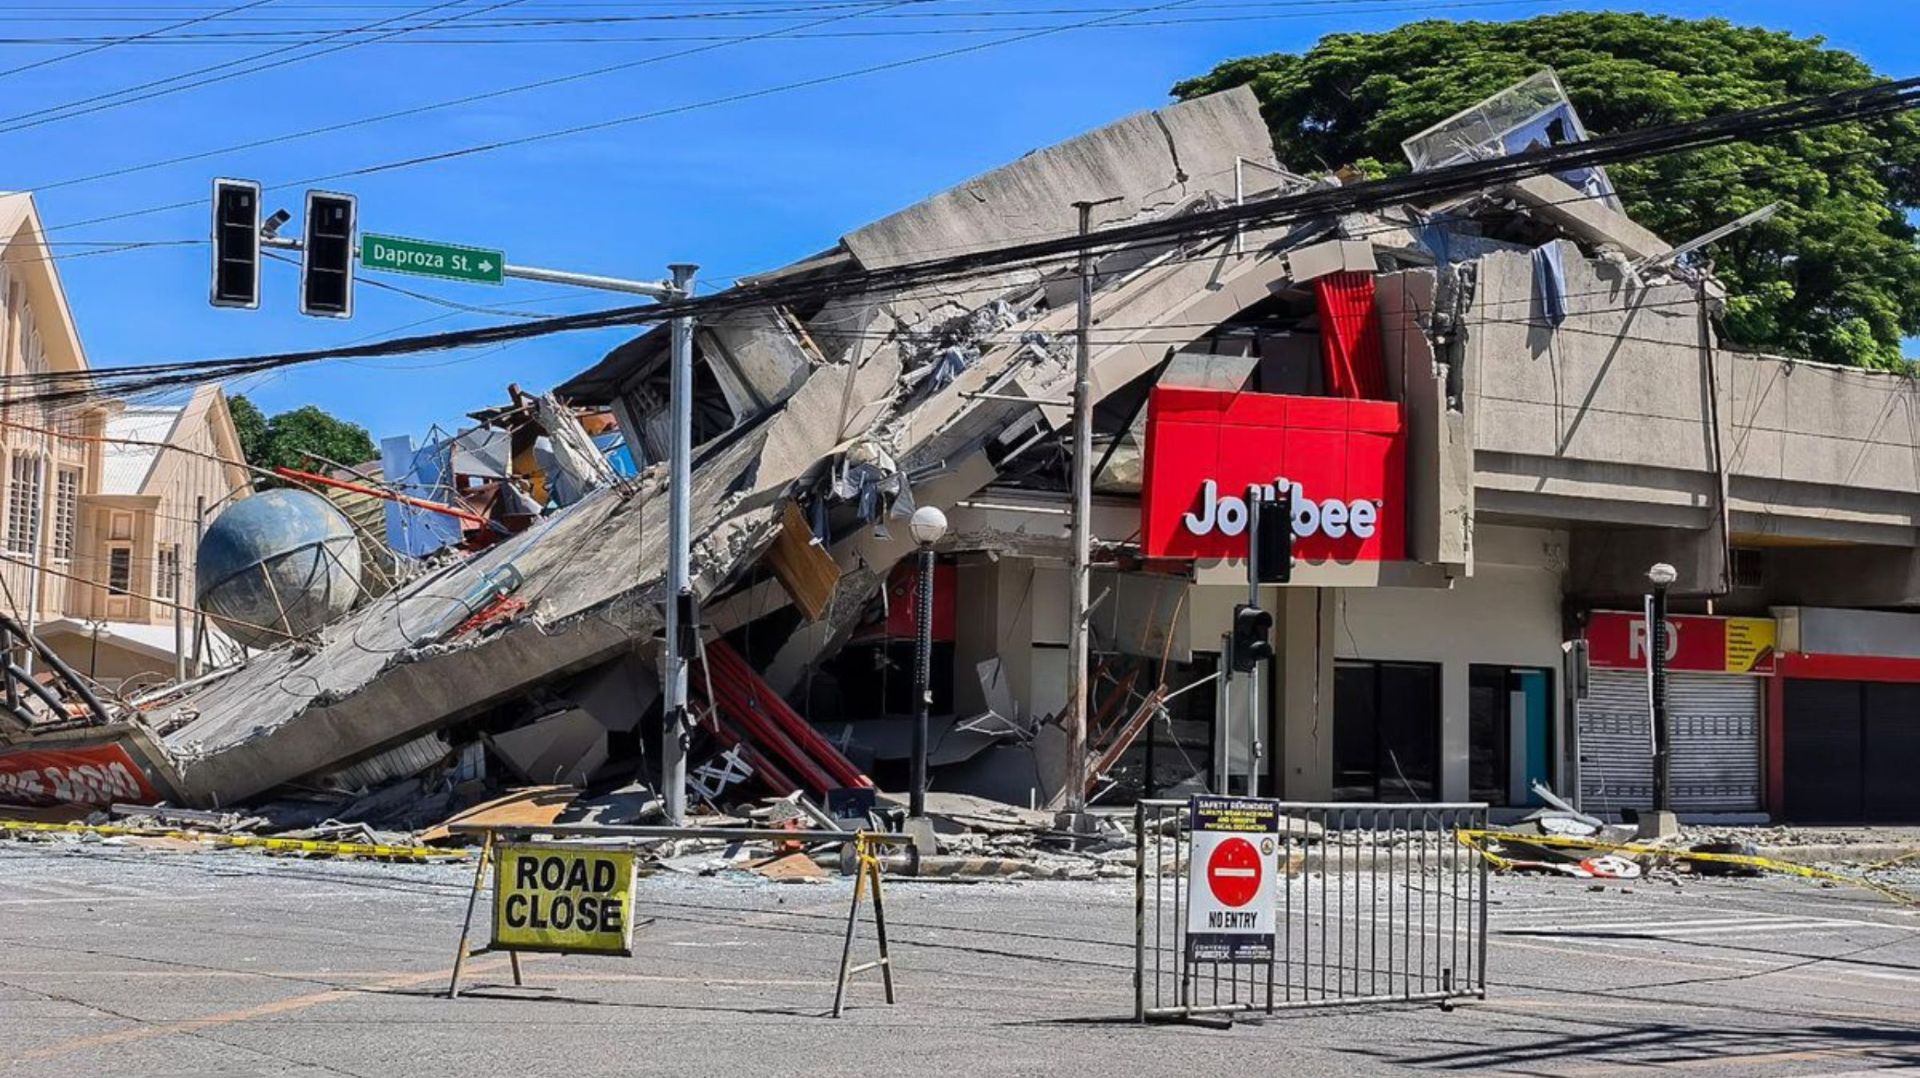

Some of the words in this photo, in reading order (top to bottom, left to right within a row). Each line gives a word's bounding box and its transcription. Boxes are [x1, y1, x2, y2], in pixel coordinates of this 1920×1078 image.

[374, 244, 444, 268] Daproza
[451, 255, 472, 272] St.
[1184, 477, 1377, 538] Jobee
[1199, 801, 1228, 809] SAFETY
[516, 856, 616, 893] ROAD
[505, 894, 623, 933] CLOSE
[1209, 911, 1223, 928] NO
[1224, 911, 1258, 928] ENTRY
